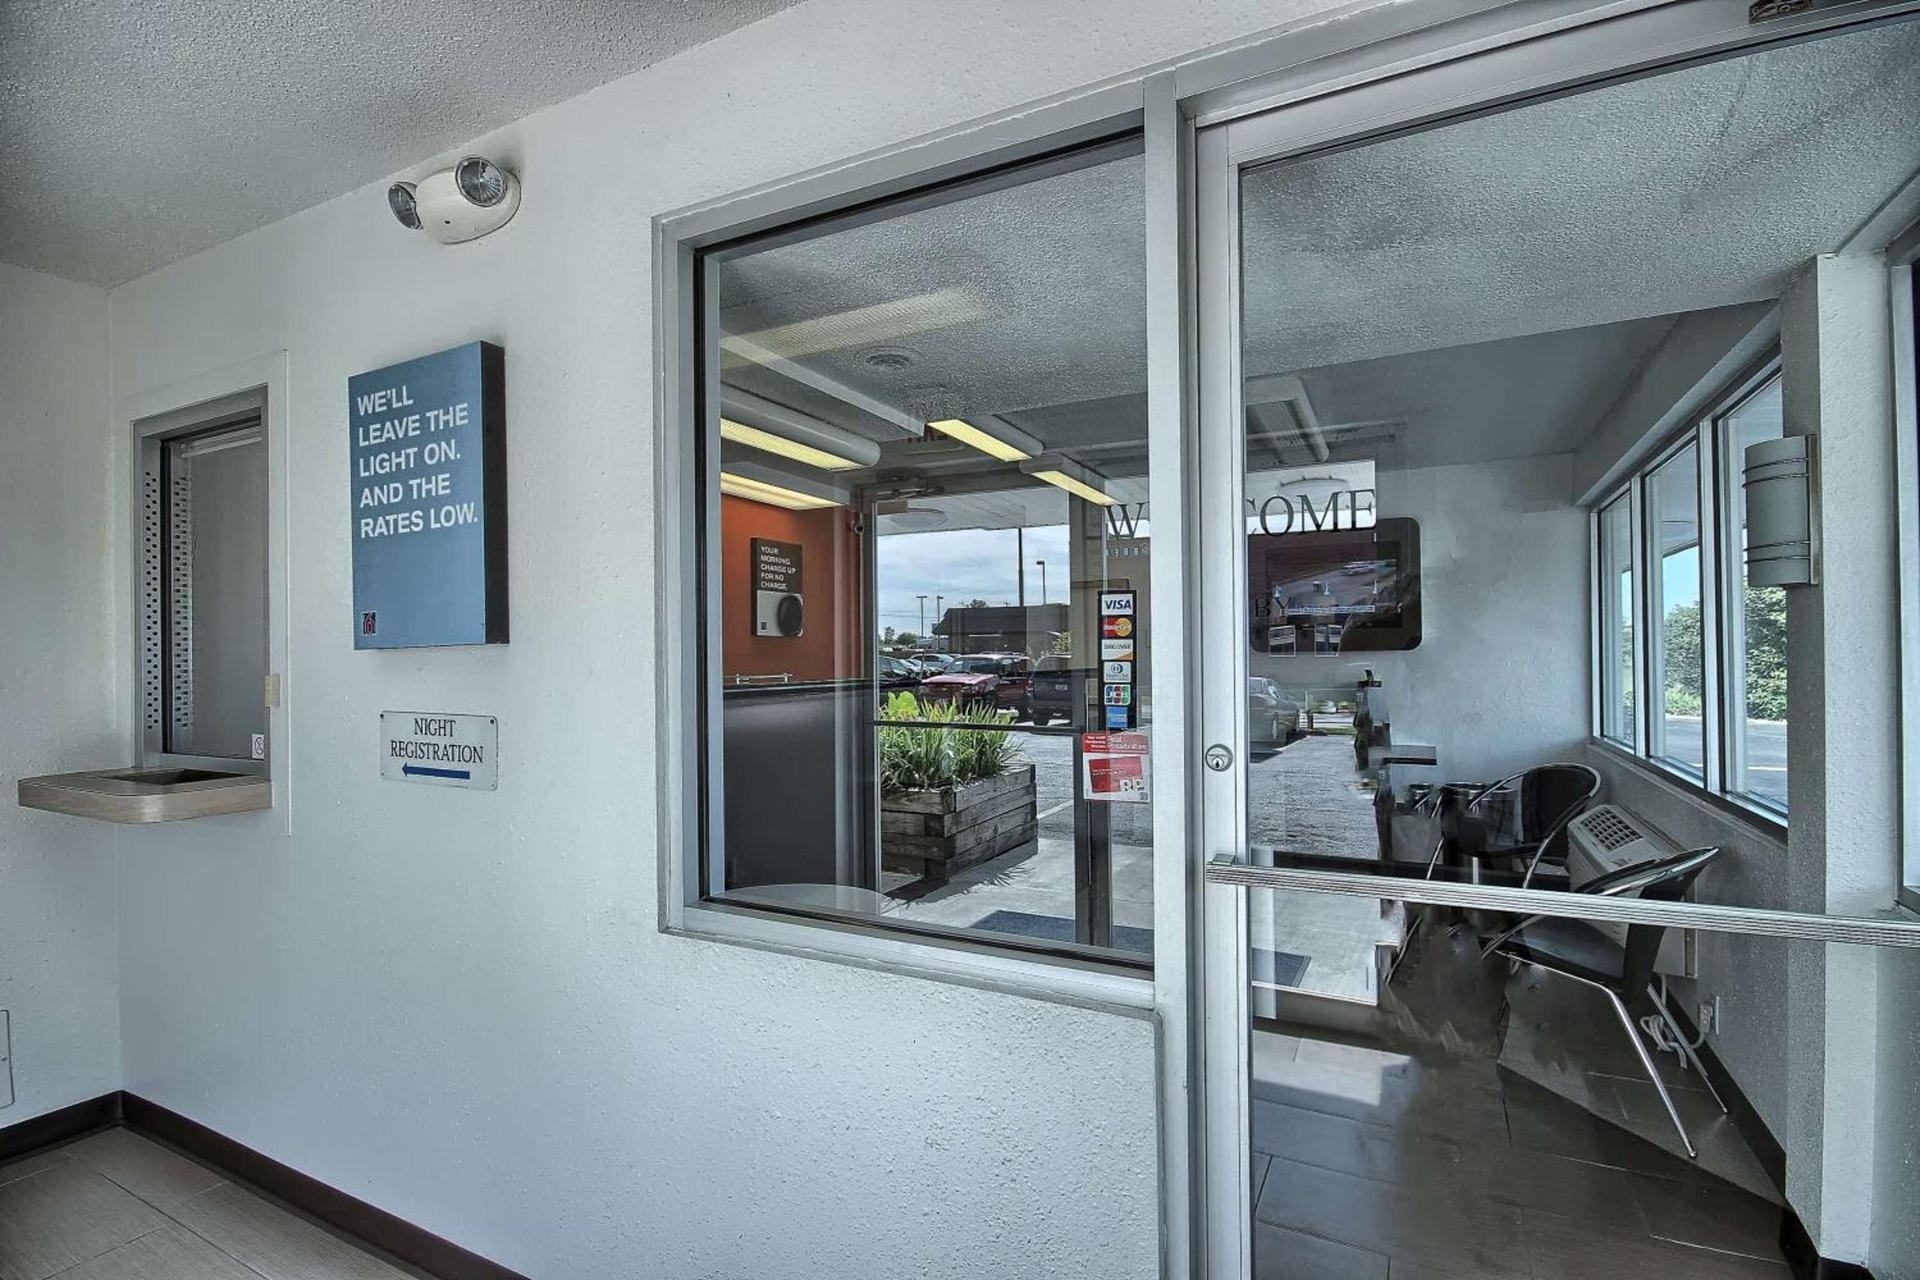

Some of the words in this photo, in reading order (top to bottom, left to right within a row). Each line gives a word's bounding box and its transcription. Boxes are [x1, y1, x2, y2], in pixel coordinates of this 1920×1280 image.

[357, 385, 414, 416] WE'LL
[358, 415, 421, 447] LEAVE
[426, 403, 469, 433] THE
[359, 448, 418, 478] LIGHT
[424, 439, 461, 466] ON.
[360, 482, 404, 509] AND
[409, 474, 451, 500] THE
[361, 510, 424, 539] RATES
[430, 502, 479, 530] LOW.
[761, 546, 779, 554] YOUR
[761, 556, 791, 565] MORNING
[760, 564, 786, 573] CHARGE
[760, 573, 774, 581] FOR
[1104, 599, 1132, 610] VISA
[414, 718, 456, 737] NIGHT
[391, 740, 484, 764] REGISTRATION
